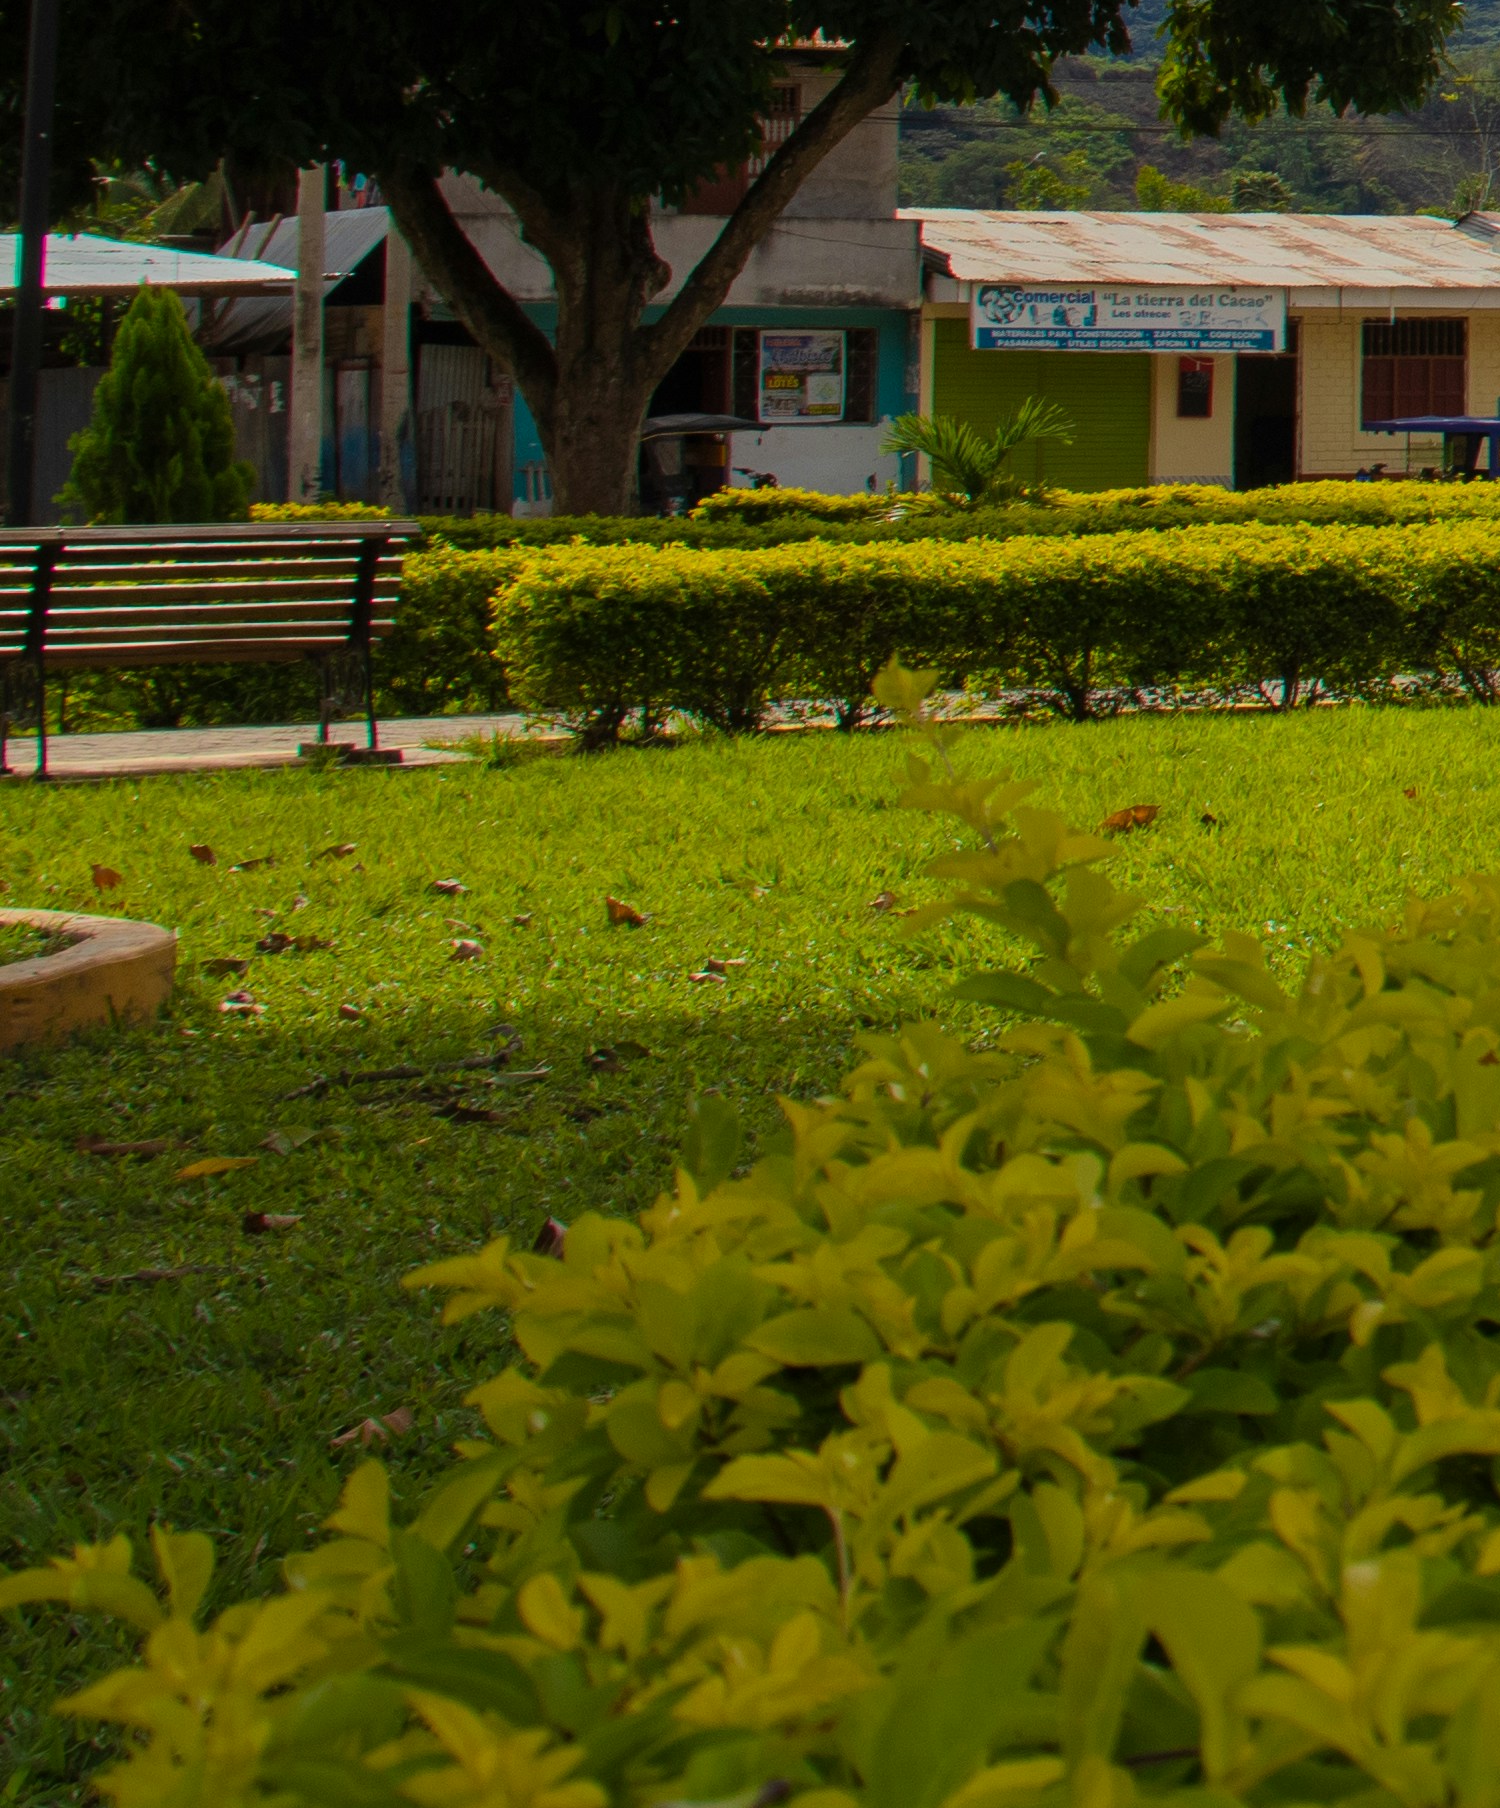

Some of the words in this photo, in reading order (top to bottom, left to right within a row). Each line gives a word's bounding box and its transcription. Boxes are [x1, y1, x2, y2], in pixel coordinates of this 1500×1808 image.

[1013, 289, 1096, 304] comercial
[1136, 292, 1185, 307] tierra
[1189, 293, 1214, 307] del
[1111, 309, 1131, 318] Les
[1133, 308, 1171, 319] ofrece:
[991, 330, 1047, 338] MATERIALES
[1048, 330, 1074, 338] PARA
[1155, 339, 1189, 348] OFICINA
[1200, 340, 1230, 348] MUCHO
[768, 378, 799, 389] LOTES
